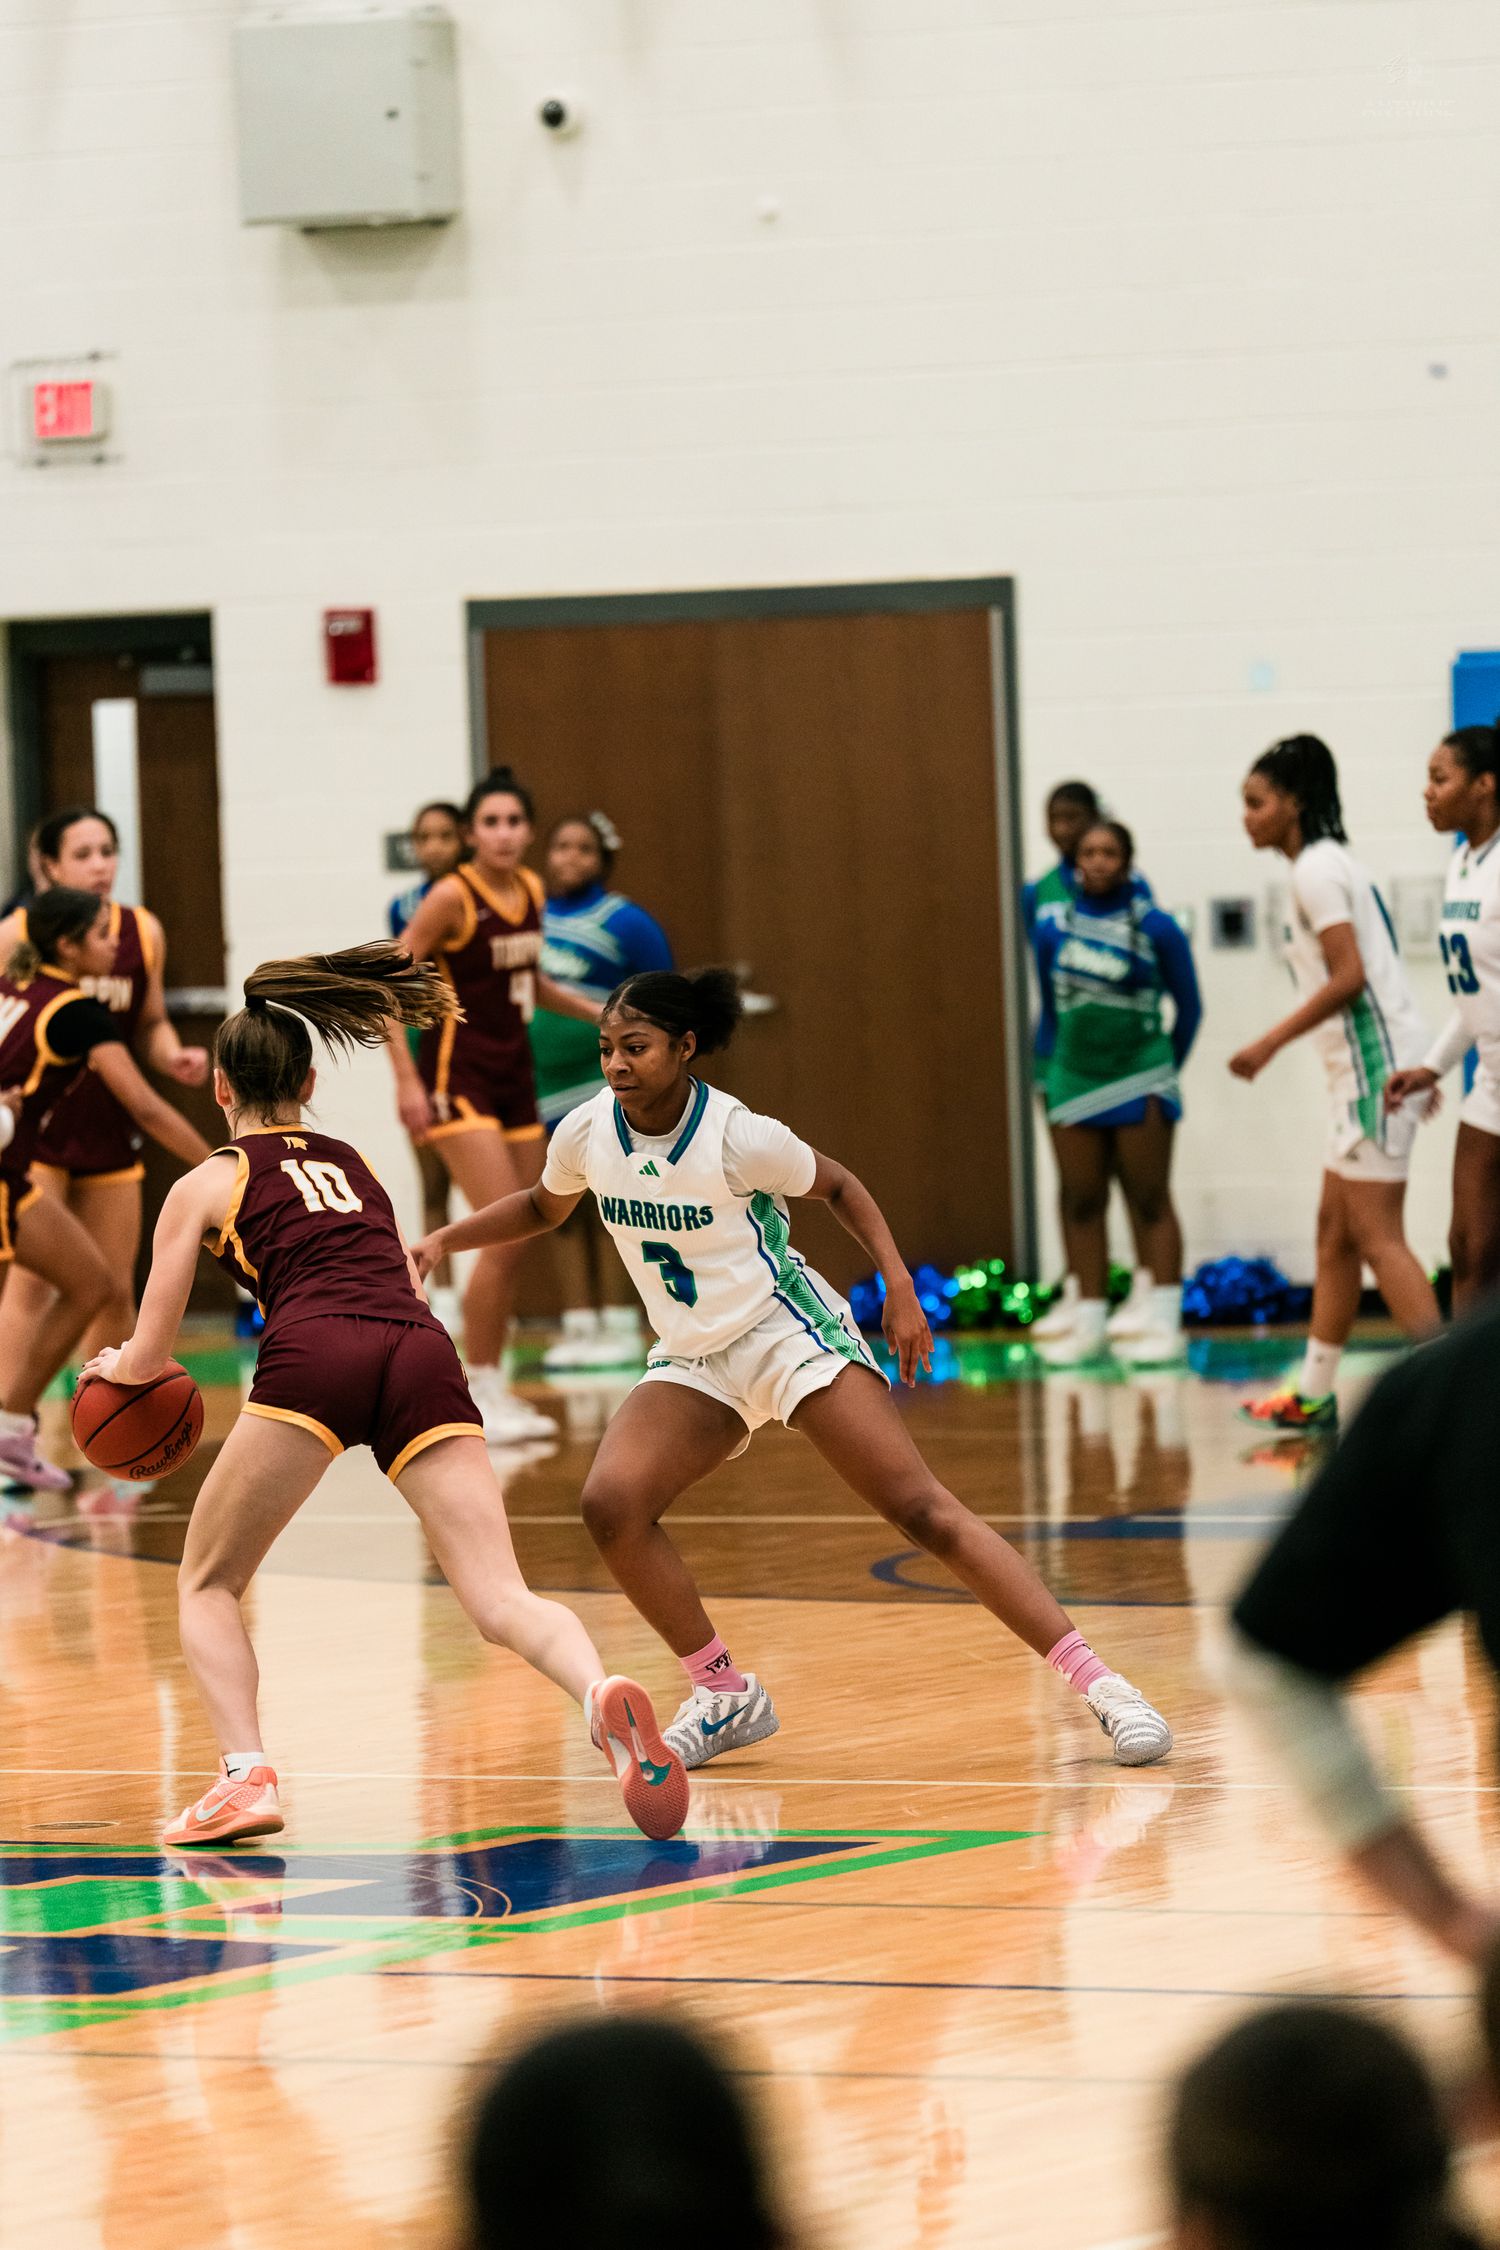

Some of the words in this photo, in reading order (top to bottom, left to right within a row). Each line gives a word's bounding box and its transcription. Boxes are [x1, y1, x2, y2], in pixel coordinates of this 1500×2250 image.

[280, 1158, 364, 1214] 10
[600, 1194, 714, 1232] WARRIORS
[641, 1240, 699, 1309] 3
[128, 1421, 193, 1479] Rawlings
